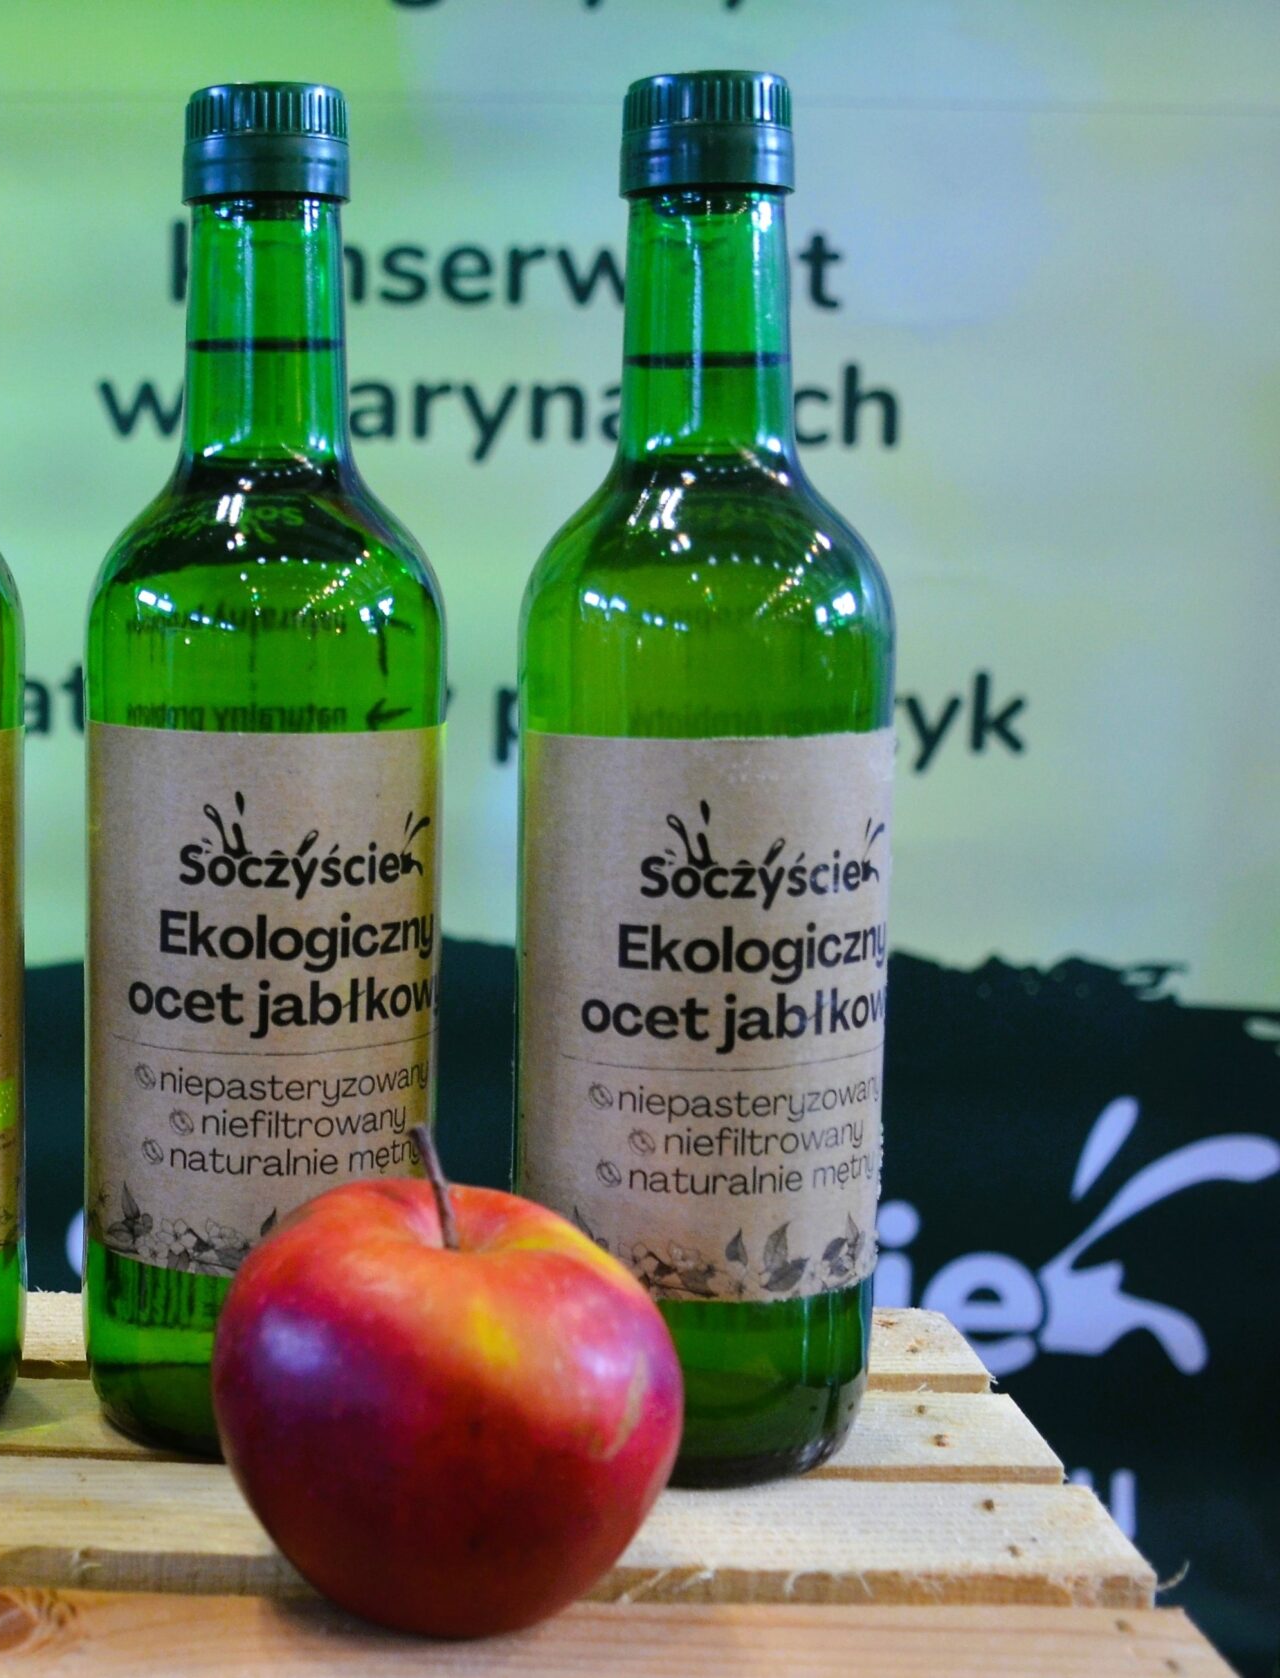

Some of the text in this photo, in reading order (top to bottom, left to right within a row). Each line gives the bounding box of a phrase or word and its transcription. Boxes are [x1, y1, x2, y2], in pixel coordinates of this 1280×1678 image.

[180, 829, 401, 899] Soczyście
[641, 838, 862, 910] Soczyście
[160, 909, 433, 972] Ekologiczny
[618, 922, 886, 984] Ekologiczny
[128, 980, 243, 1025] ocet
[582, 987, 884, 1054] ocet jabłkow
[160, 1058, 429, 1105] niepasteryzowany
[202, 1105, 406, 1139] niefiltrowany
[664, 1118, 863, 1157] niefiltrowany
[170, 1143, 338, 1176] naturalnie
[628, 1160, 802, 1195] naturalnie
